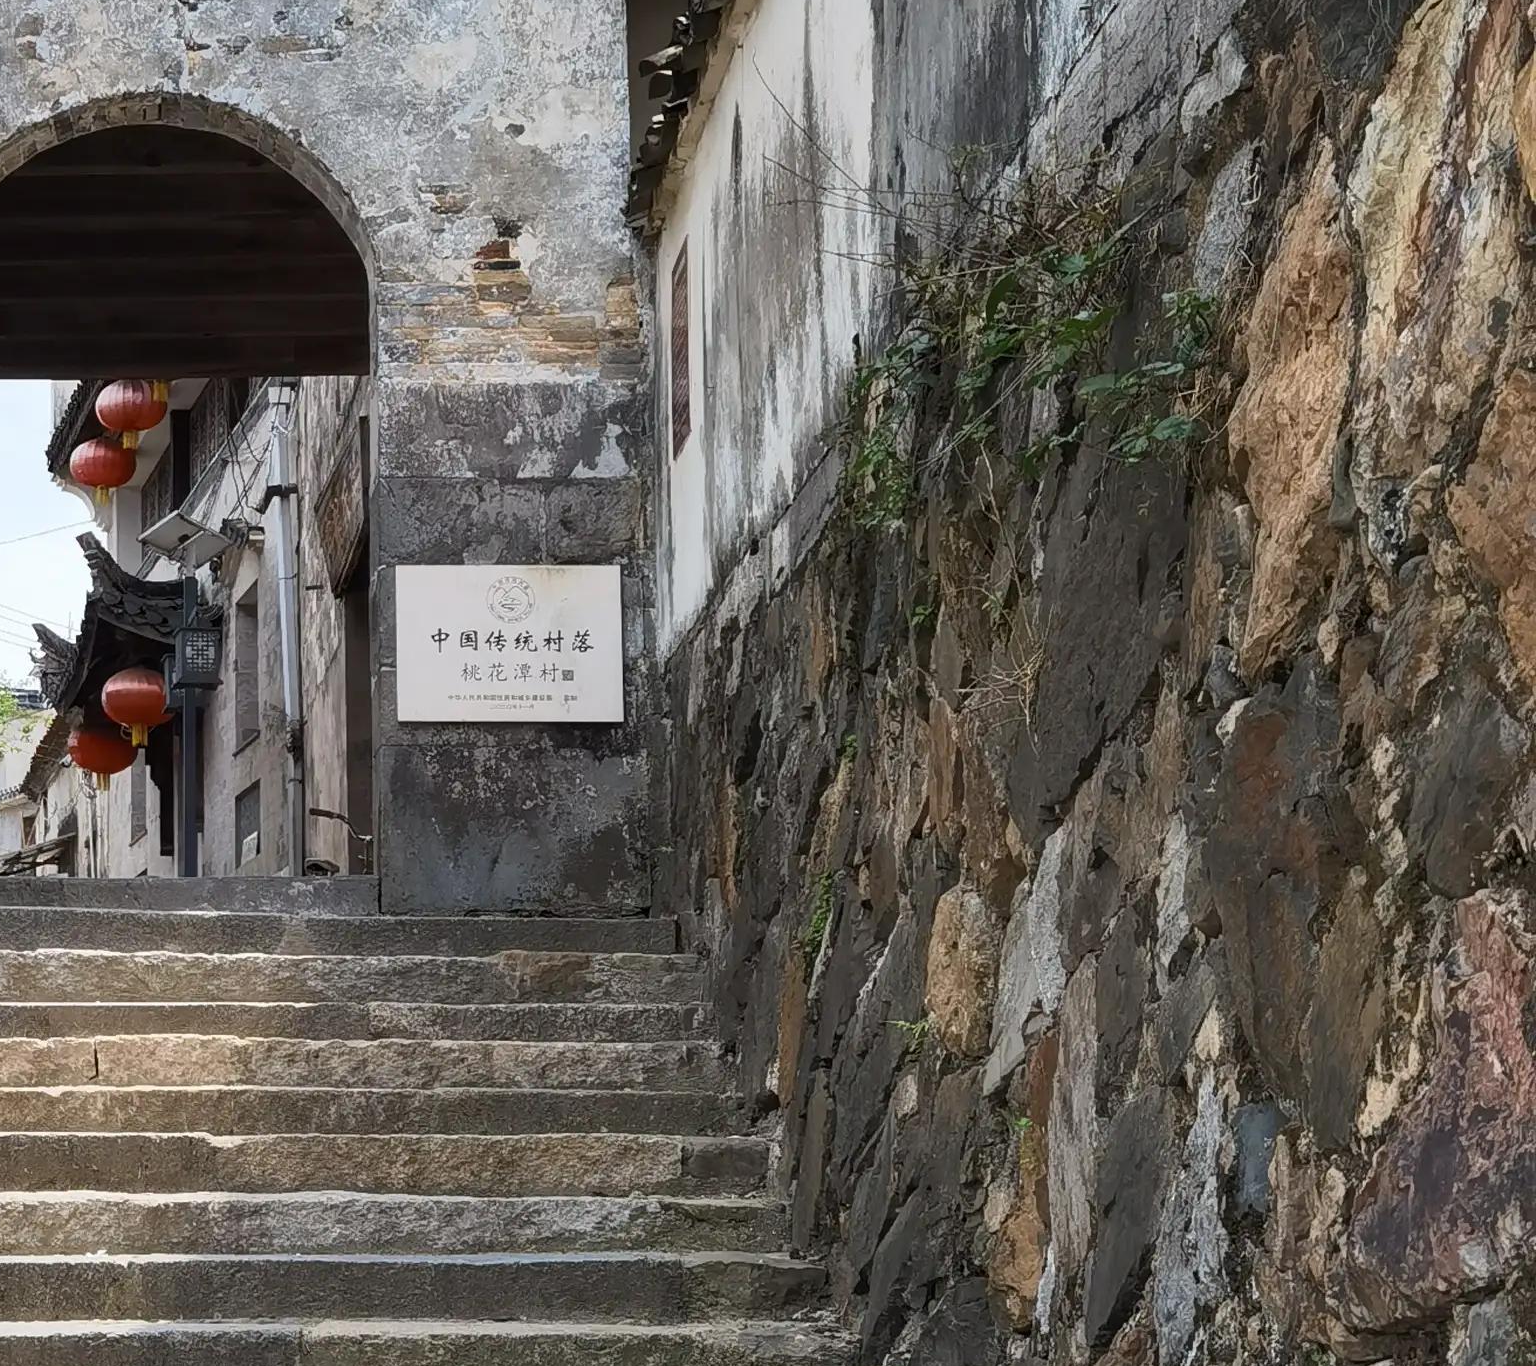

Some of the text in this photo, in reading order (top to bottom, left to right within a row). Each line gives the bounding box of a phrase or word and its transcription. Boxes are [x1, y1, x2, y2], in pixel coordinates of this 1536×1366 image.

[430, 627, 595, 653] 中国传统村落
[460, 662, 560, 683] 桃花潭村
